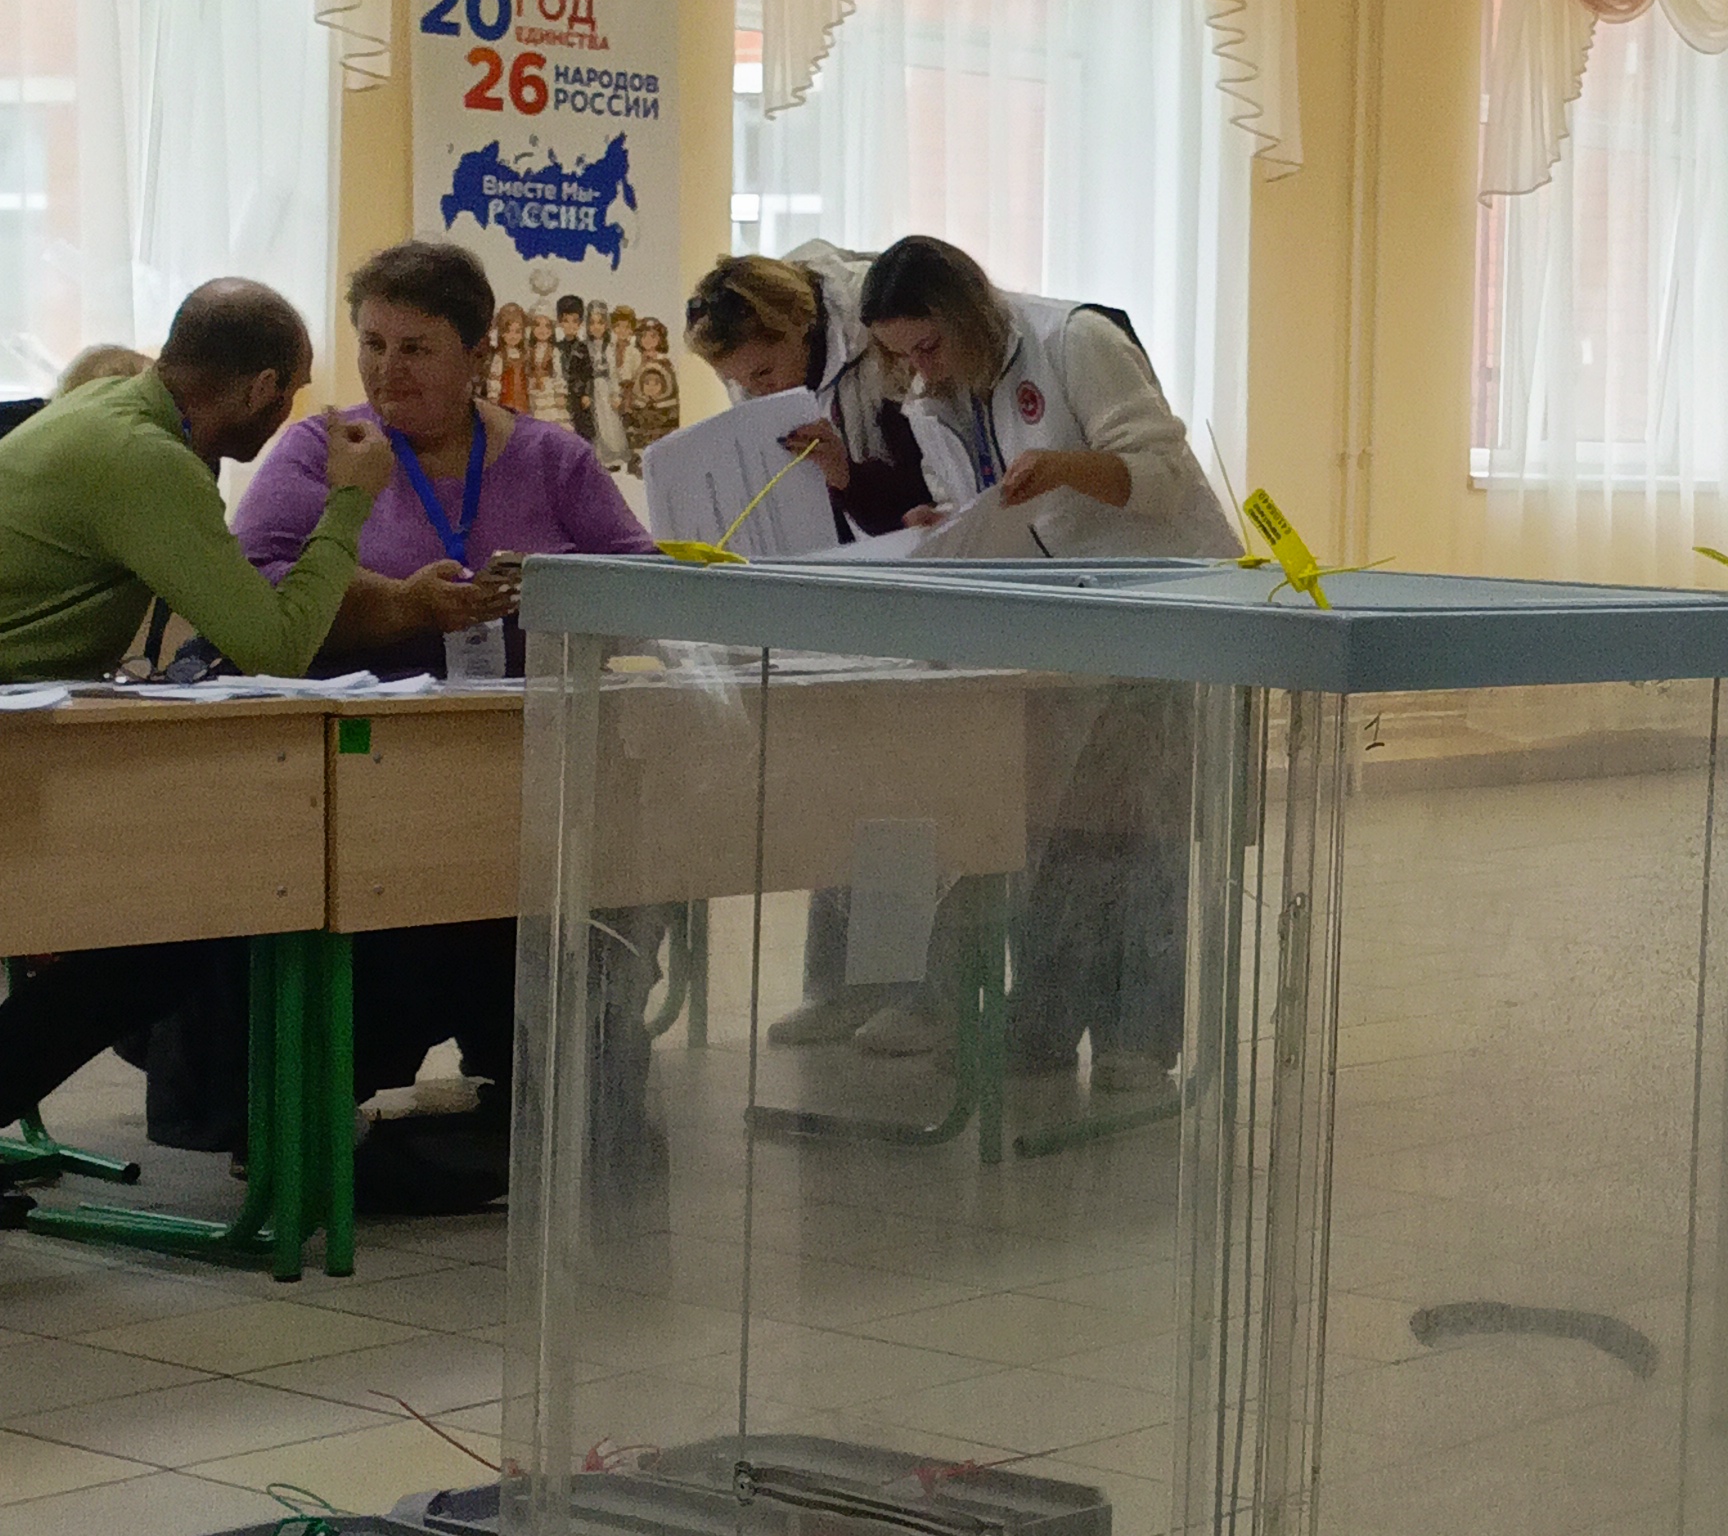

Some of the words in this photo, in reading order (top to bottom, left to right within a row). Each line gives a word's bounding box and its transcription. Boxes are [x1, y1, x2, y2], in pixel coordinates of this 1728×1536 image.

[464, 46, 549, 116] 26
[554, 64, 660, 93] НАРОДОВ
[553, 88, 660, 120] РОССИИ
[482, 174, 557, 200] Вместе
